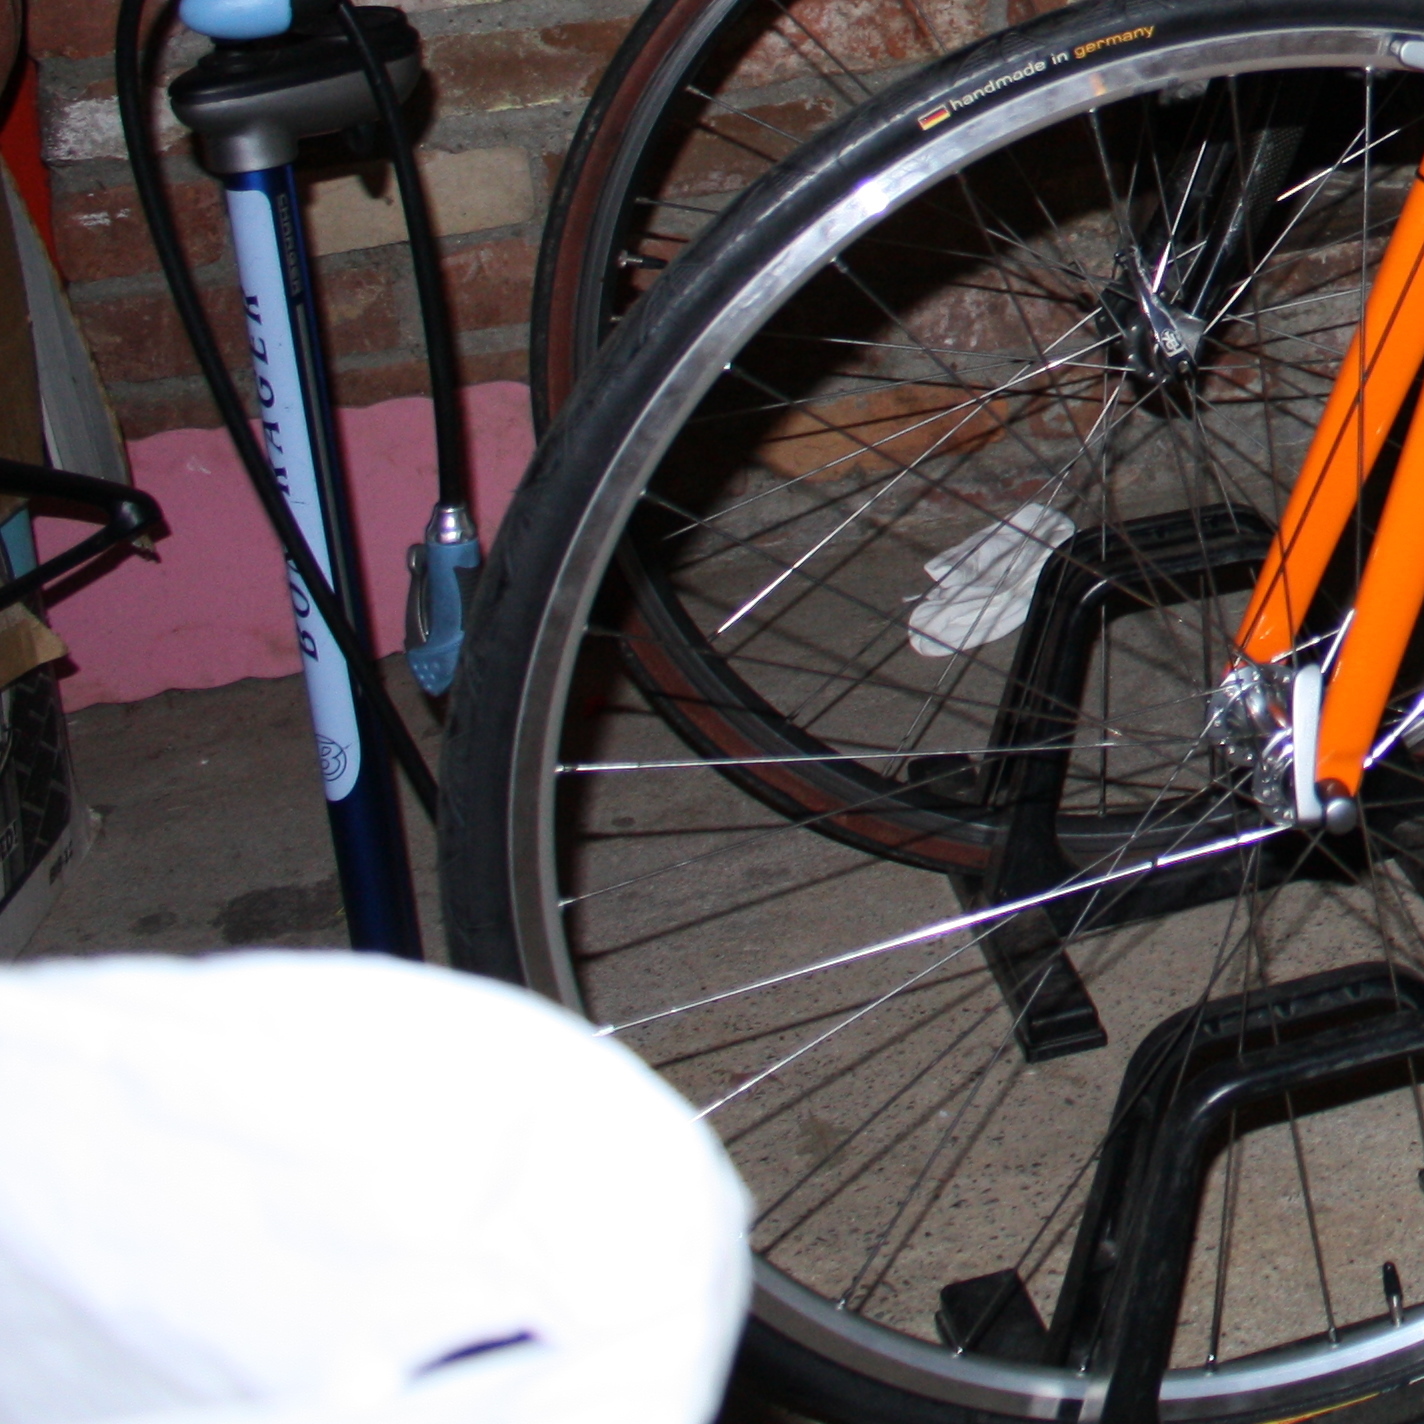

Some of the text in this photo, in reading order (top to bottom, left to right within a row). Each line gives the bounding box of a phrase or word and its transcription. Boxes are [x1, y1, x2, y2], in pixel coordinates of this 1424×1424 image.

[950, 25, 1155, 111] handmade in germany
[242, 291, 319, 662] BORAGER
